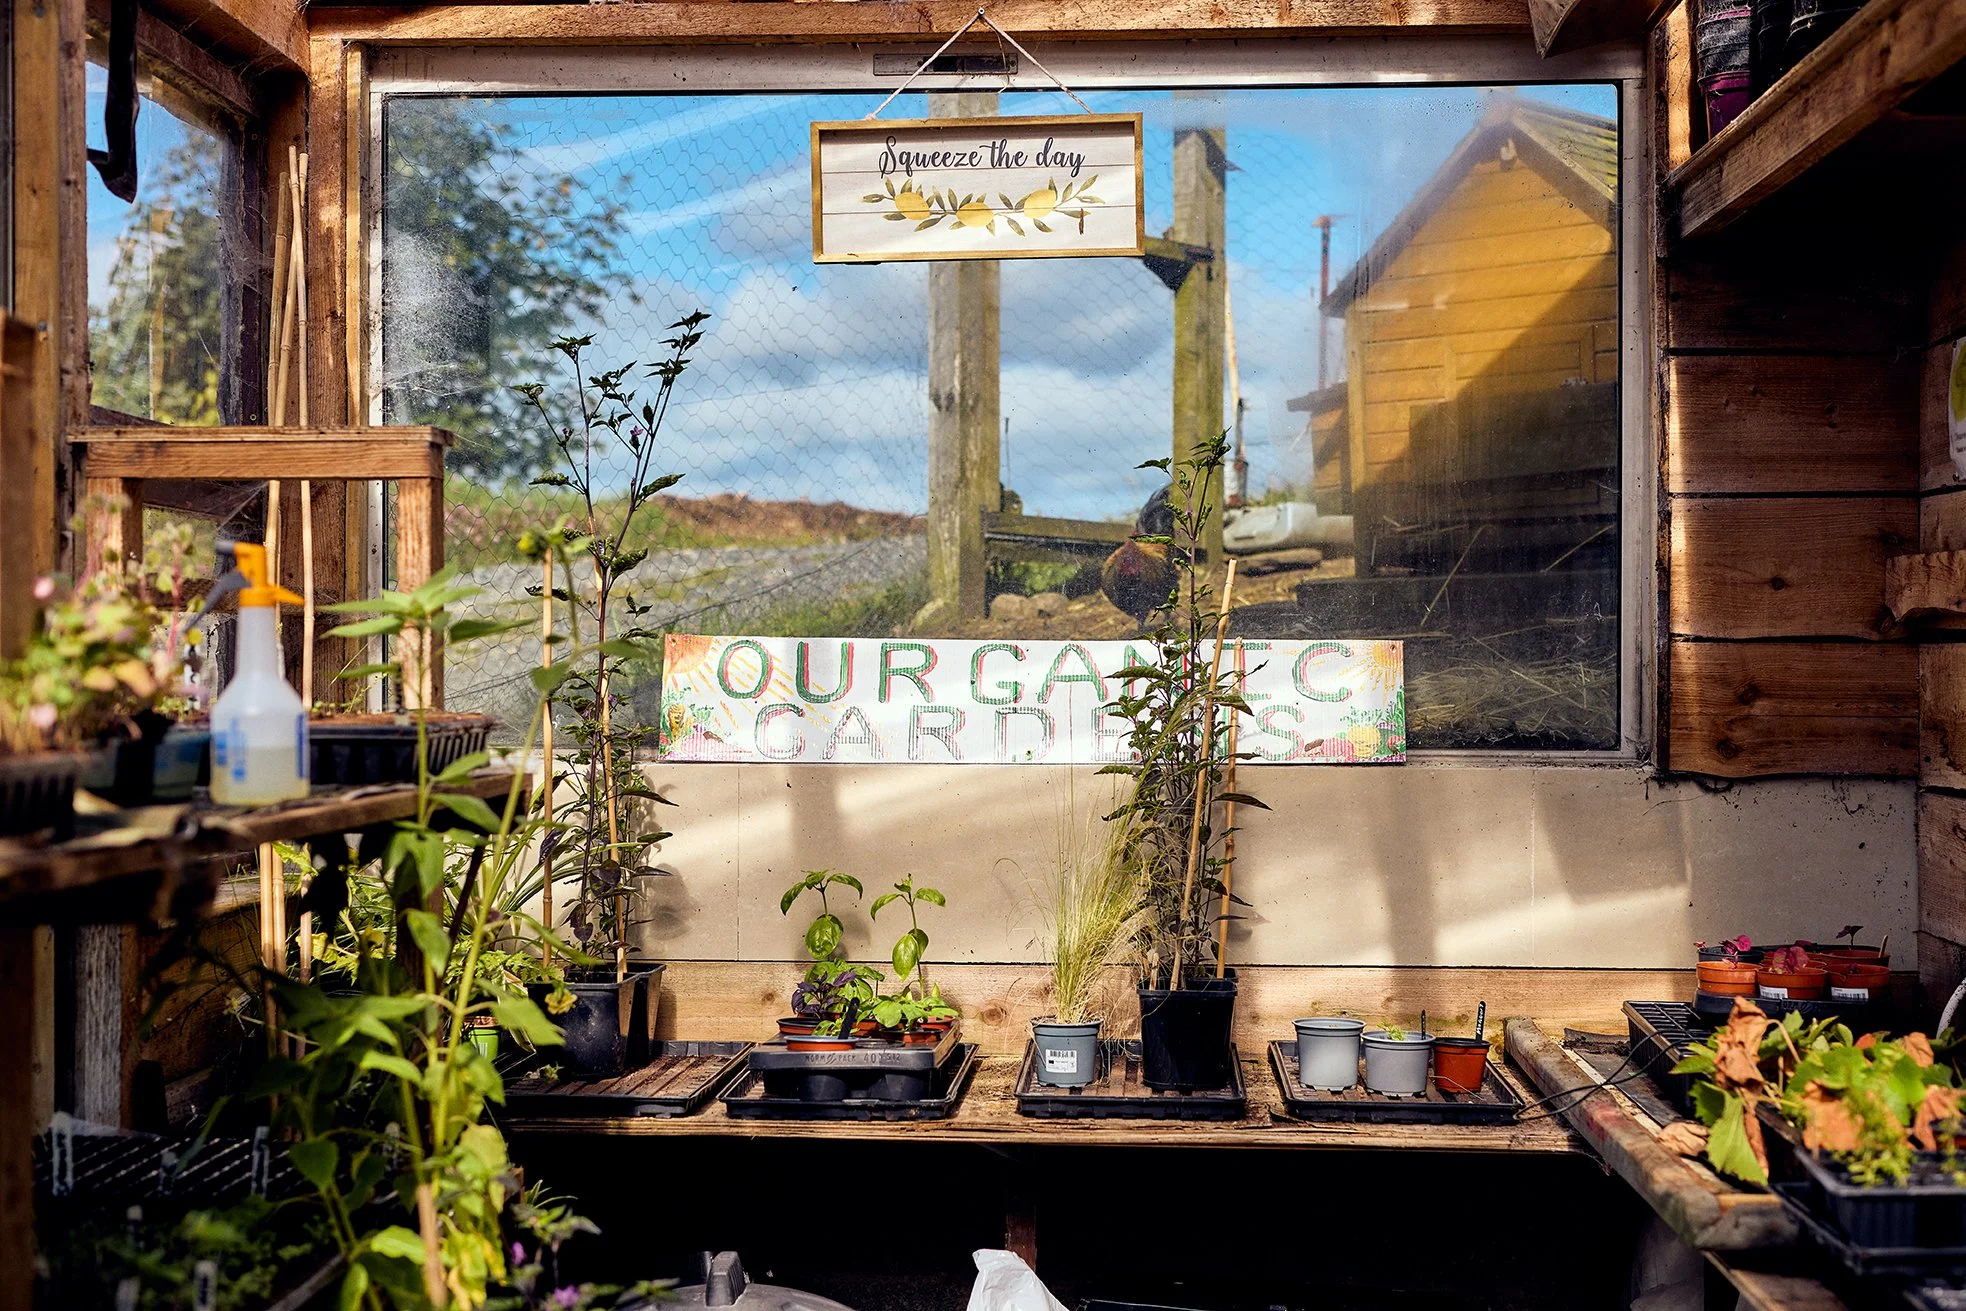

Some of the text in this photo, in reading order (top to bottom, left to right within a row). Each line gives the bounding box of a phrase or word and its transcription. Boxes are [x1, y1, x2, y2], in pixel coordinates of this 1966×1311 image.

[879, 135, 1086, 179] Squeeze the day
